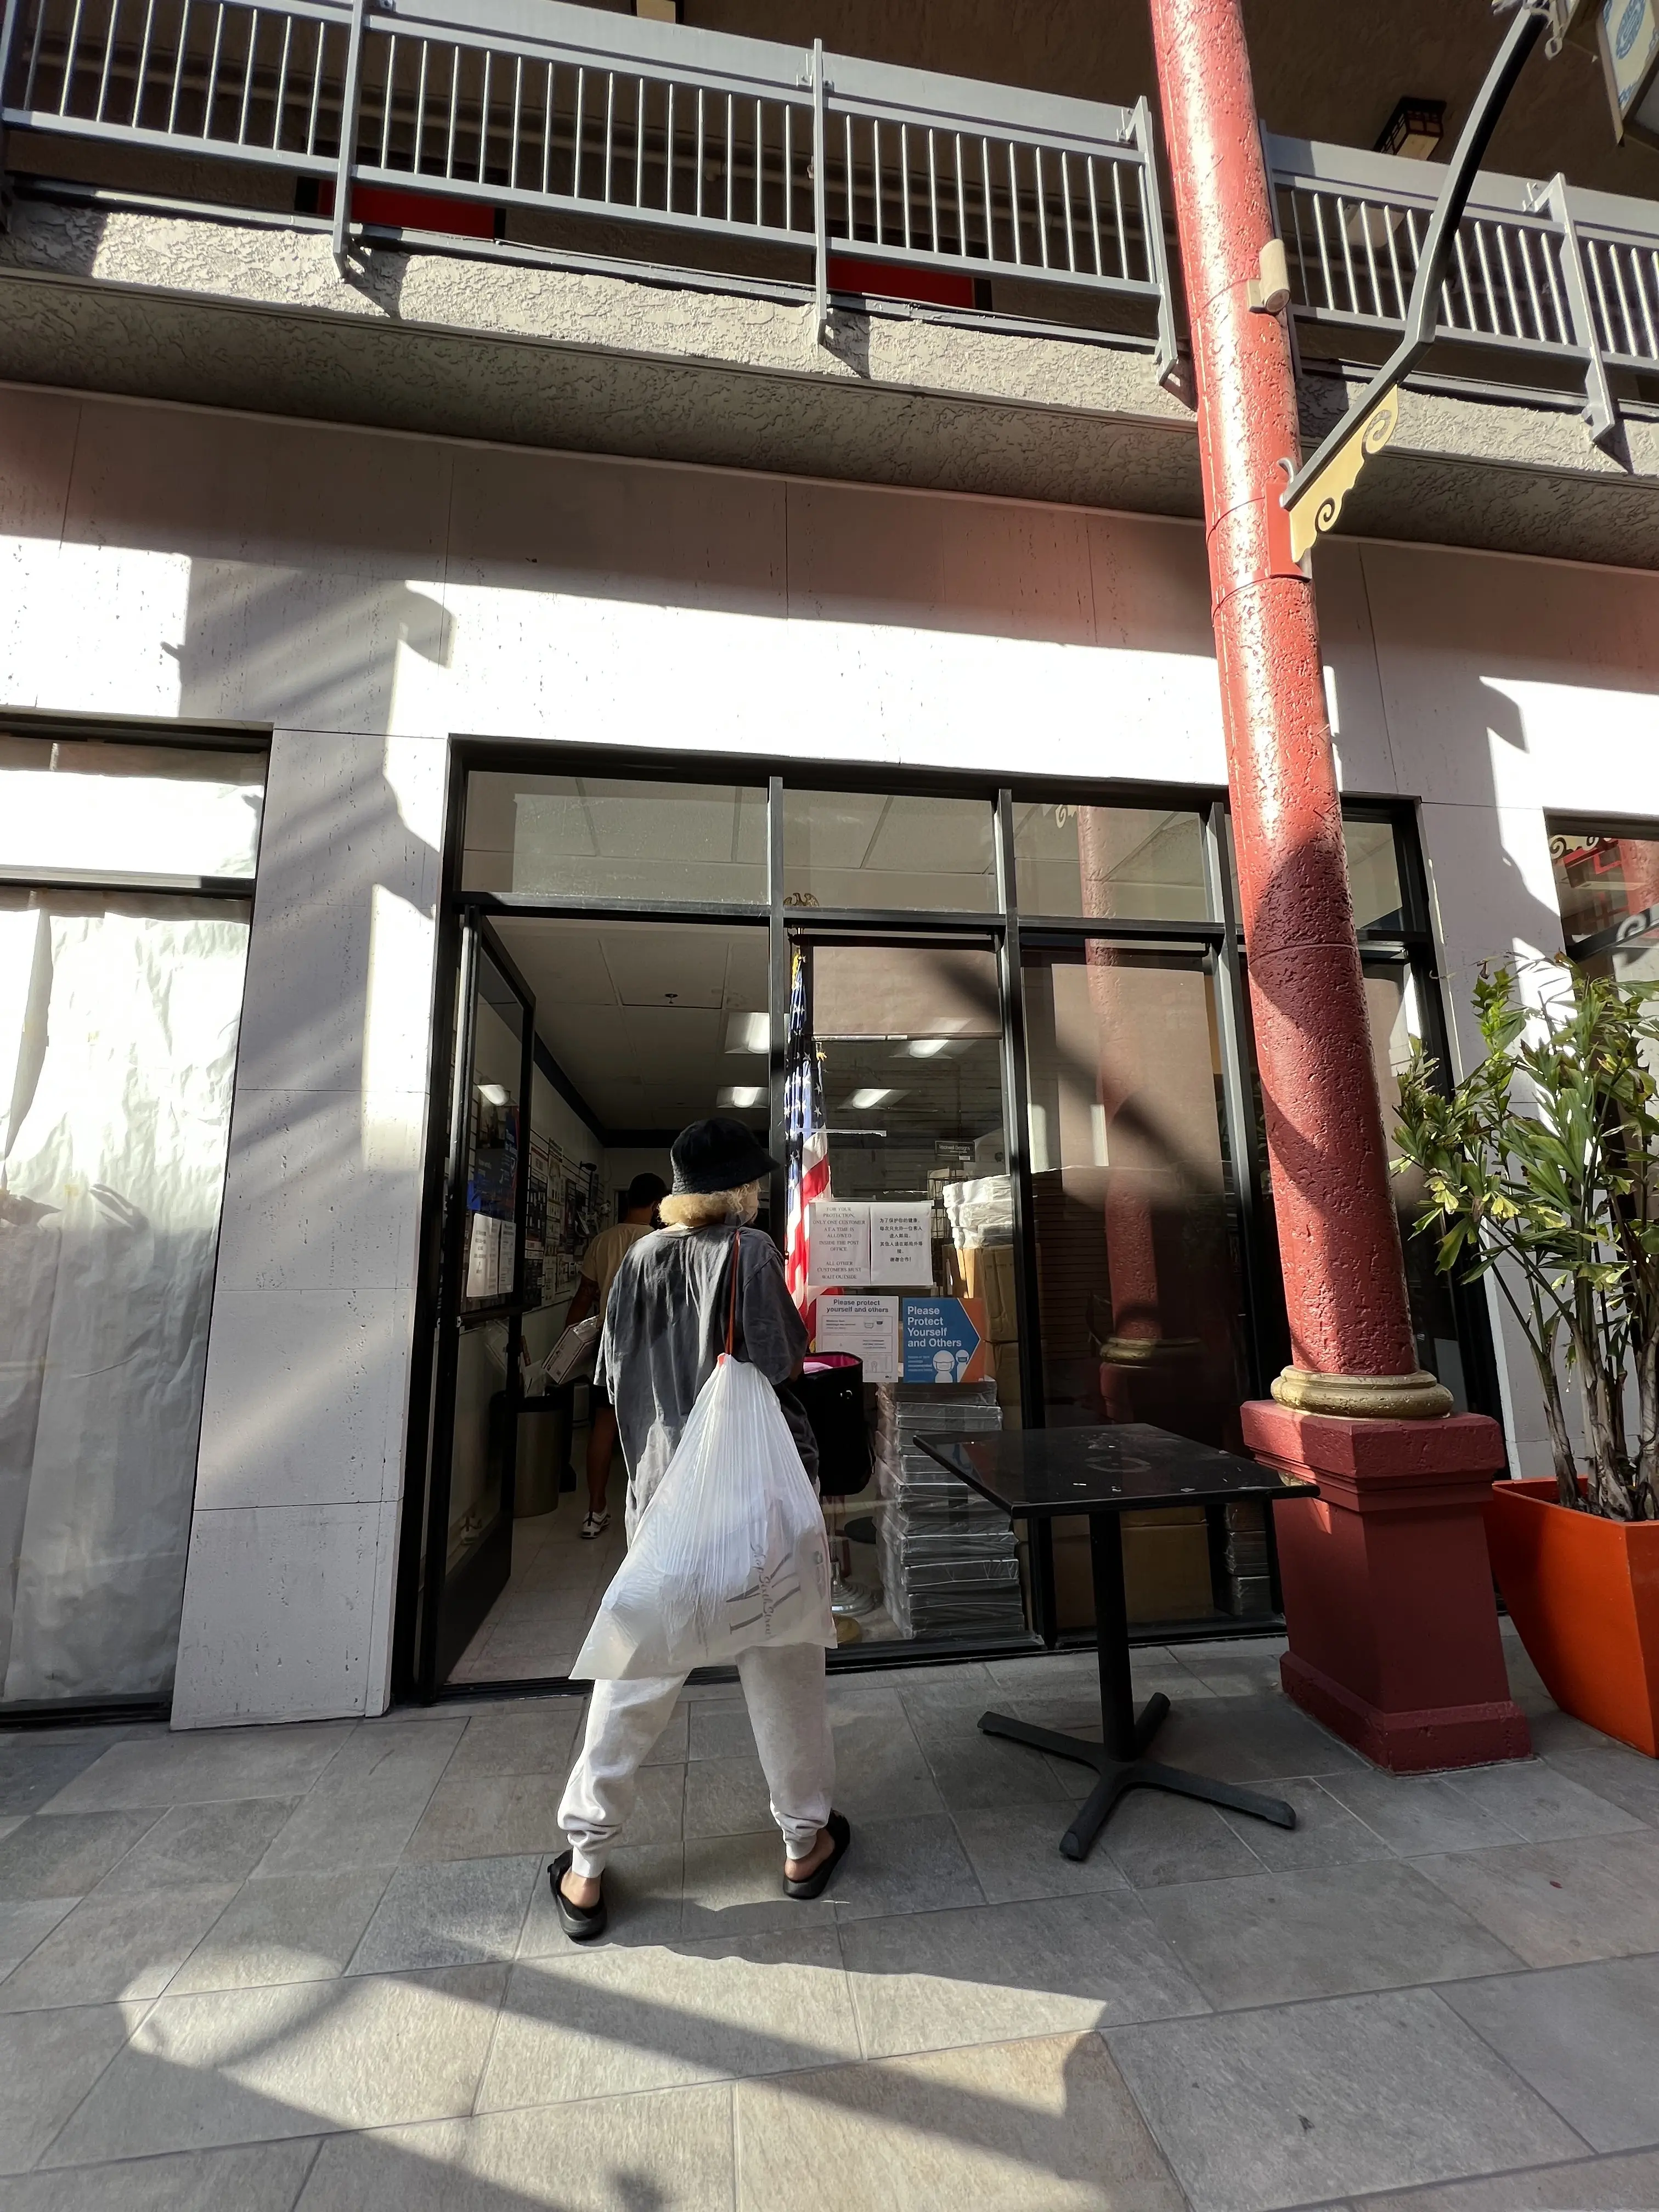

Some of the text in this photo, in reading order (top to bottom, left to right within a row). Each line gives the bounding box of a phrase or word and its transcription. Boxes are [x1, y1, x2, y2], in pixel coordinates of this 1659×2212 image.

[907, 1306, 940, 1315] Please
[907, 1317, 944, 1325] Protect
[907, 1327, 947, 1336] Yourself
[907, 1338, 962, 1347] and Others
